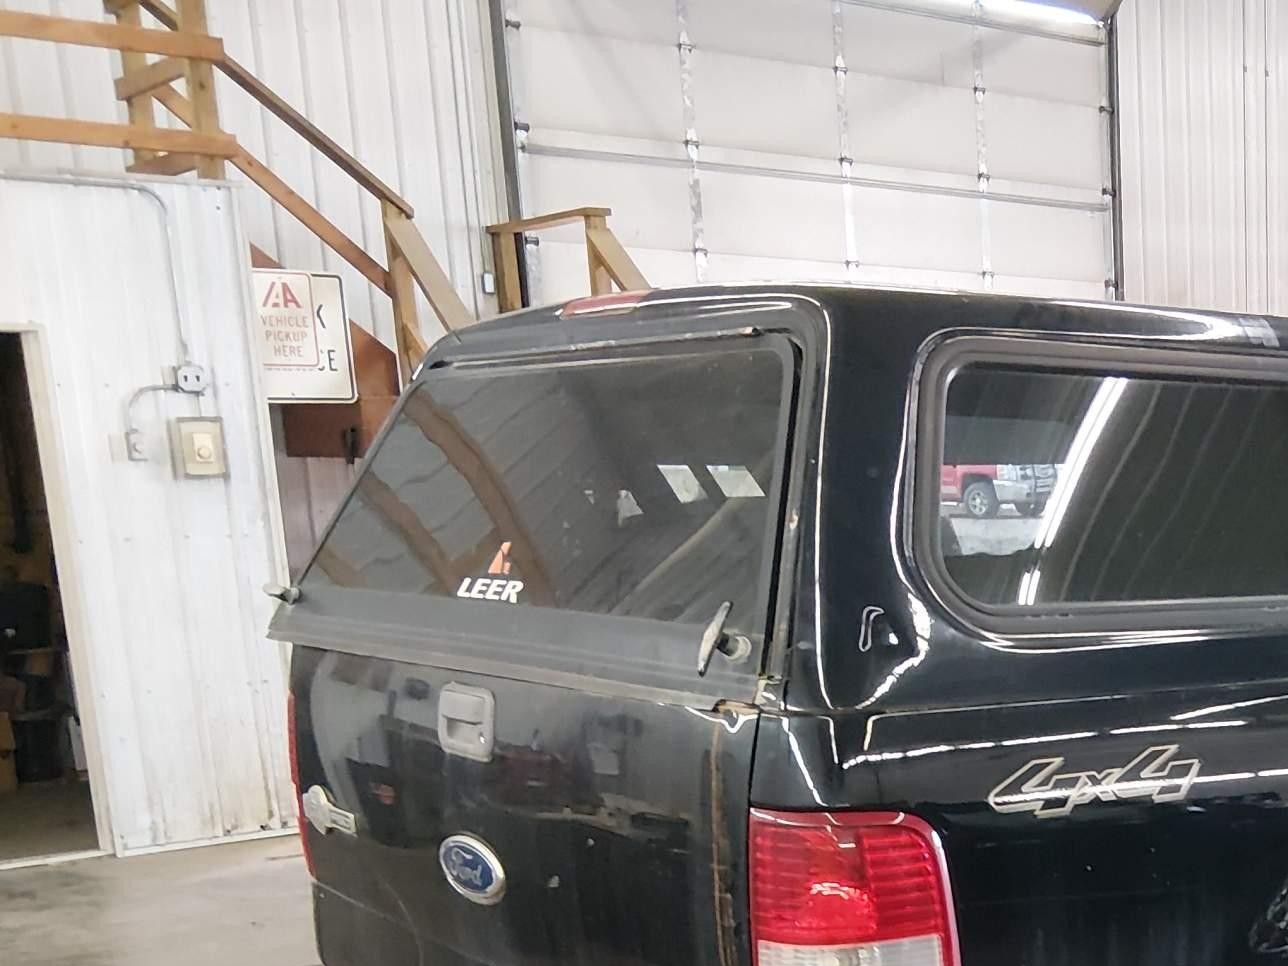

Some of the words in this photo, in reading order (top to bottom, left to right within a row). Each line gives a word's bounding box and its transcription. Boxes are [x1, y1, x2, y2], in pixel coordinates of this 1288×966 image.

[260, 315, 309, 328] VEHICLE
[265, 330, 308, 342] PICKUP
[273, 345, 304, 357] HERE
[457, 577, 524, 604] LEER
